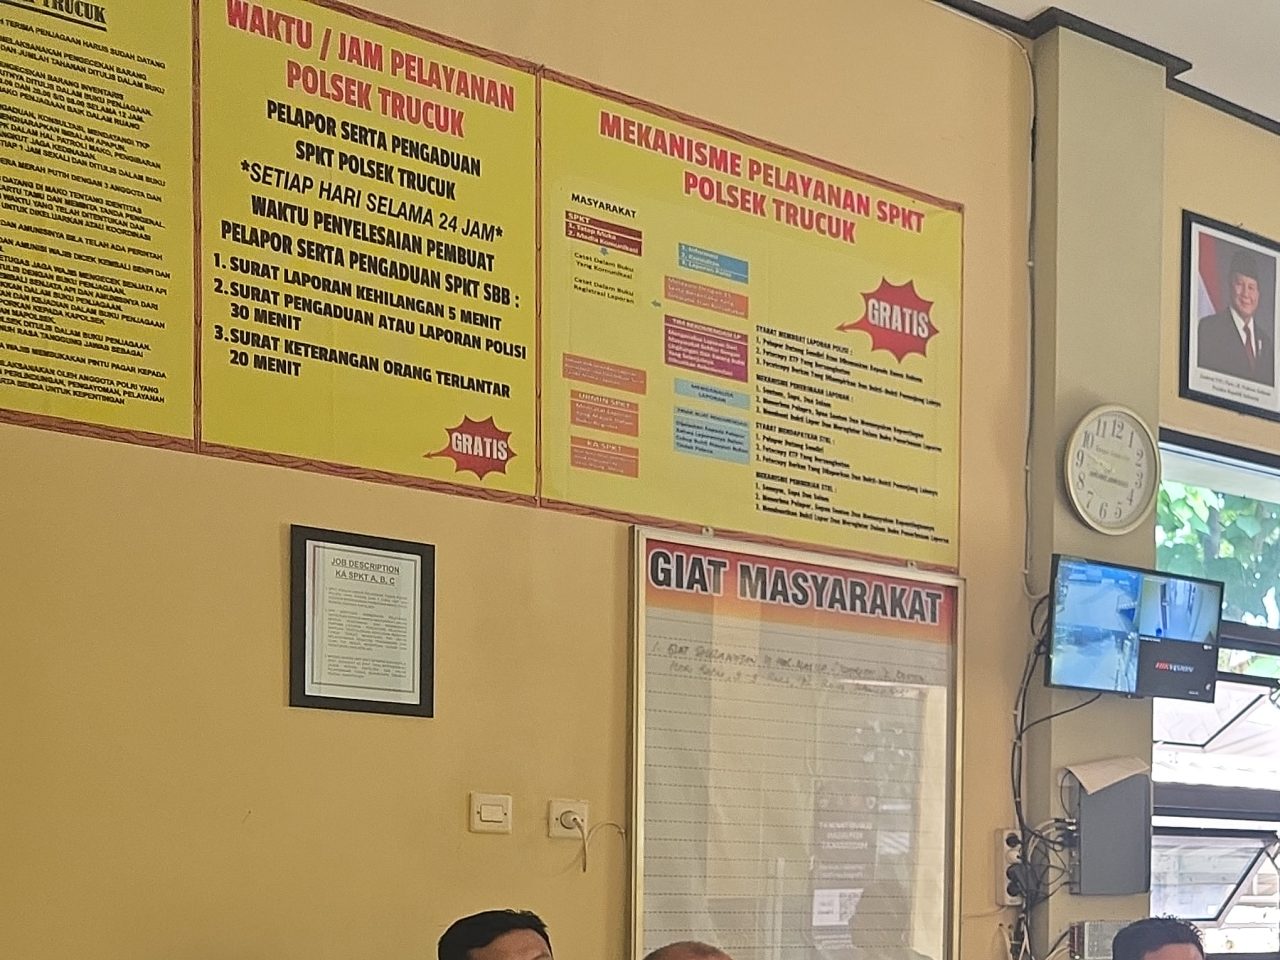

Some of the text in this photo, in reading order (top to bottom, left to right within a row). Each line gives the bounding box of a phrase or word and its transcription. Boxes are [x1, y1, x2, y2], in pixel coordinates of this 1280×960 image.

[227, 0, 514, 111] WAKTU / JAM PELAYANAN
[287, 60, 464, 137] POLSEK TRUCUK
[267, 100, 480, 177] PELAPOR SERTA PENGADUAN
[296, 141, 455, 200] SPKT POLSEK TRUCUK
[600, 111, 924, 233] MEKANISME PELAYANAN SPKT
[319, 181, 360, 208] HARI
[367, 194, 433, 226] SELAMA
[440, 213, 457, 232] 24
[568, 213, 590, 224] SPKT
[571, 193, 636, 218] MASYARAKAT
[684, 171, 855, 243] POLSEK TRUCUK
[252, 195, 494, 272] WAKTU PENYELESAIAN PEMBUAT
[221, 219, 292, 255] PELAPOR
[298, 243, 344, 267] SERTA
[350, 251, 440, 290] PENGADUAN
[445, 275, 479, 299] SPKT
[484, 283, 510, 305] SBB
[213, 253, 501, 331] 1. SURAT LAPORAN KEHILANGAN 5 MENIT
[213, 278, 526, 359] 2. SURAT PENGADUAN ATAU LAPORAN POLISI
[231, 303, 301, 330] 30 MENIT
[868, 299, 930, 339] GRATIS
[214, 324, 510, 398] 3. SURAT KETERANGAN ORANG TERLANTAR
[229, 350, 301, 376] 20 MENIT
[1083, 431, 1094, 448] 10
[1096, 419, 1106, 438] 11
[1112, 419, 1124, 440] 12
[1129, 431, 1134, 448] 1
[452, 431, 508, 461] GRATIS
[1076, 450, 1084, 467] 9
[1136, 450, 1144, 467] 2
[1077, 472, 1085, 489] 8
[1135, 472, 1143, 488] 3
[1087, 491, 1093, 508] 7
[1099, 502, 1108, 519] 6
[1115, 501, 1121, 519] 5
[1127, 489, 1134, 506] 4
[331, 558, 399, 574] JOB DESCRIPTION
[335, 570, 347, 578] KA
[349, 571, 368, 581] SPKT
[389, 577, 395, 585] C
[651, 551, 941, 624] GIAT MASYARAKAT
